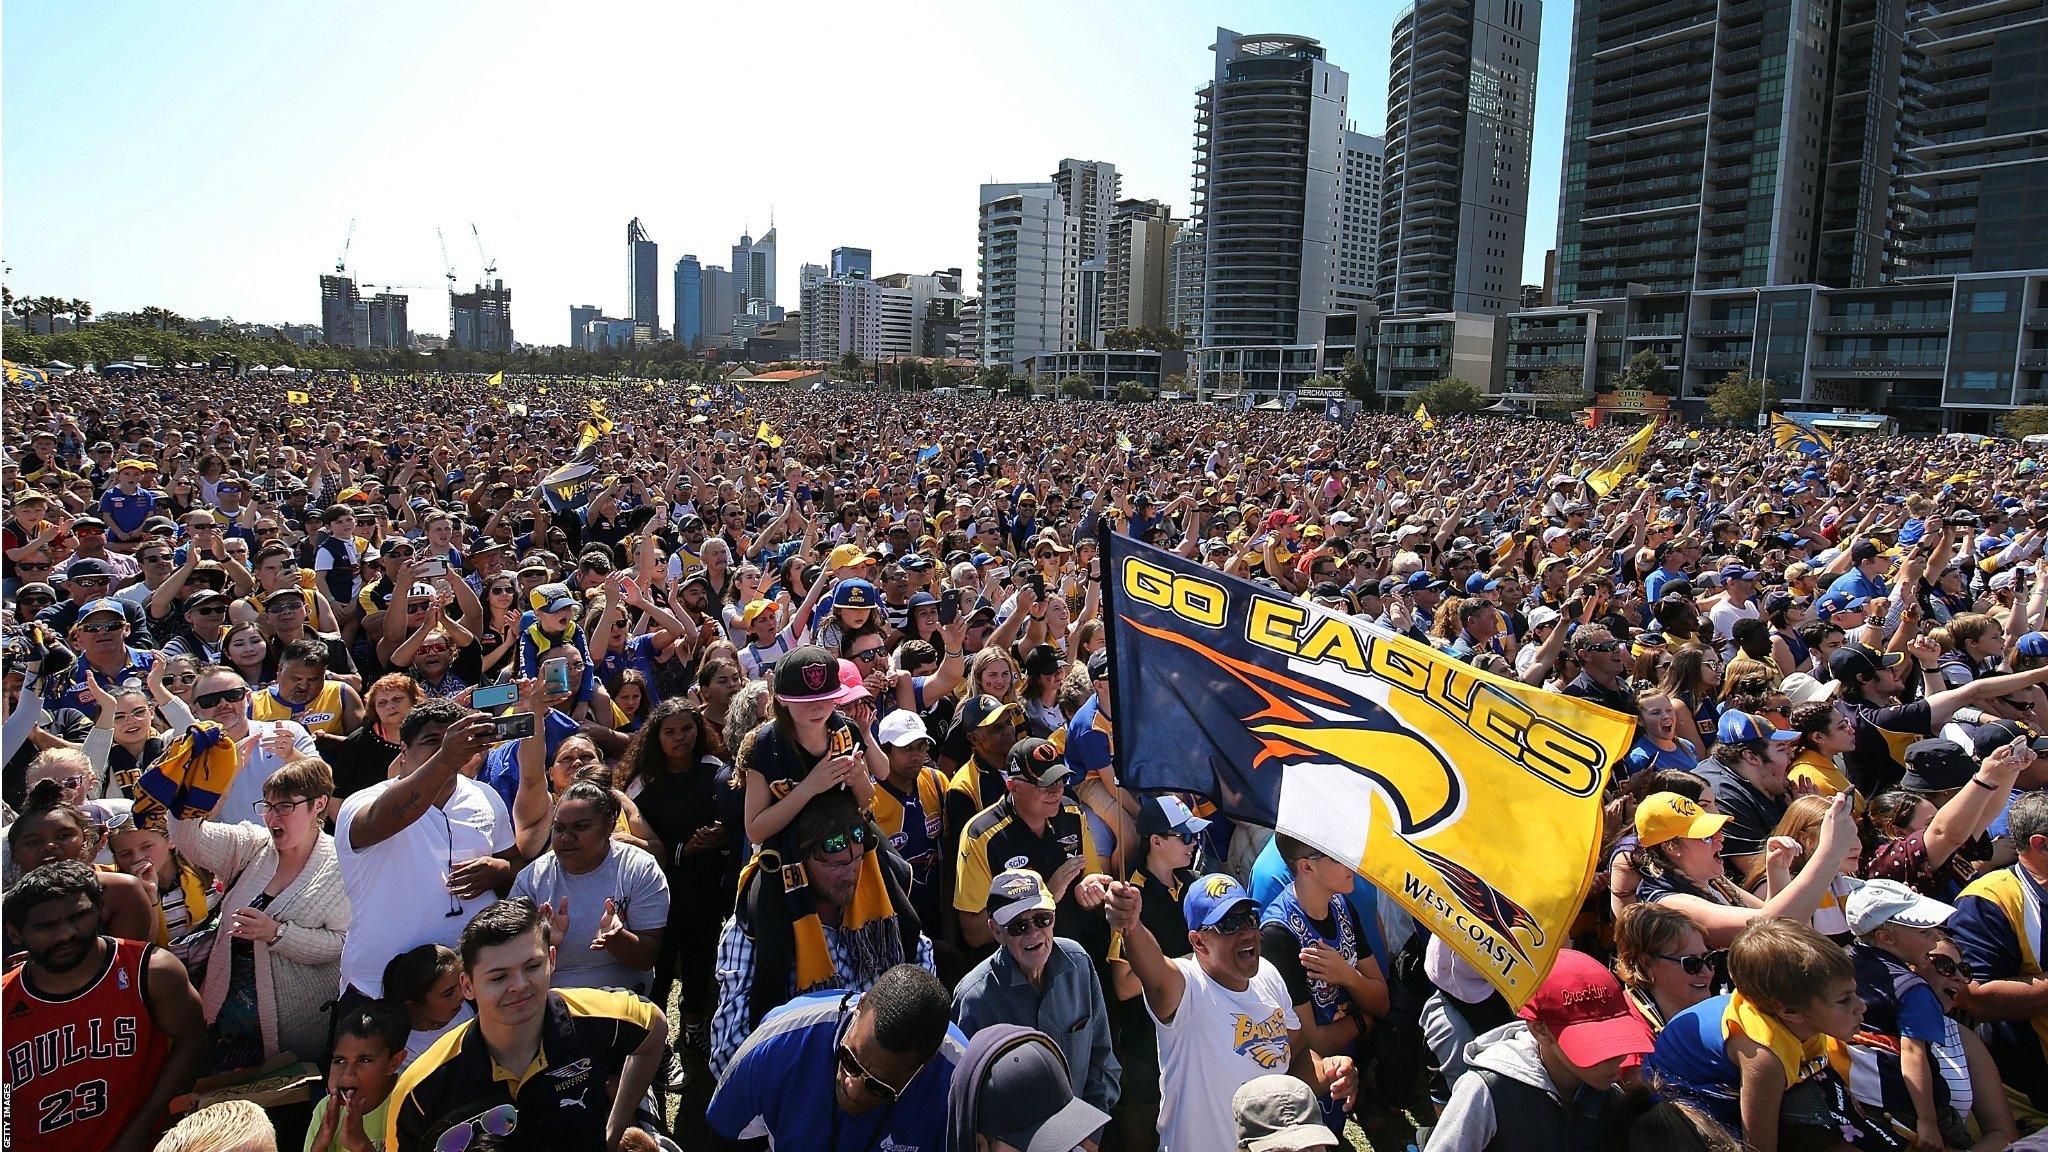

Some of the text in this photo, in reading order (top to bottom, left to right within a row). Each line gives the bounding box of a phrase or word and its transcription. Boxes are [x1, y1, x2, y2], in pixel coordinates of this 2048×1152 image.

[1298, 389, 1344, 398] MERCHANDISE
[1121, 556, 1605, 797] GO EAGLES
[1403, 871, 1519, 978] WEST COAST
[7, 1016, 136, 1091] BULLS
[38, 1078, 108, 1133] 23
